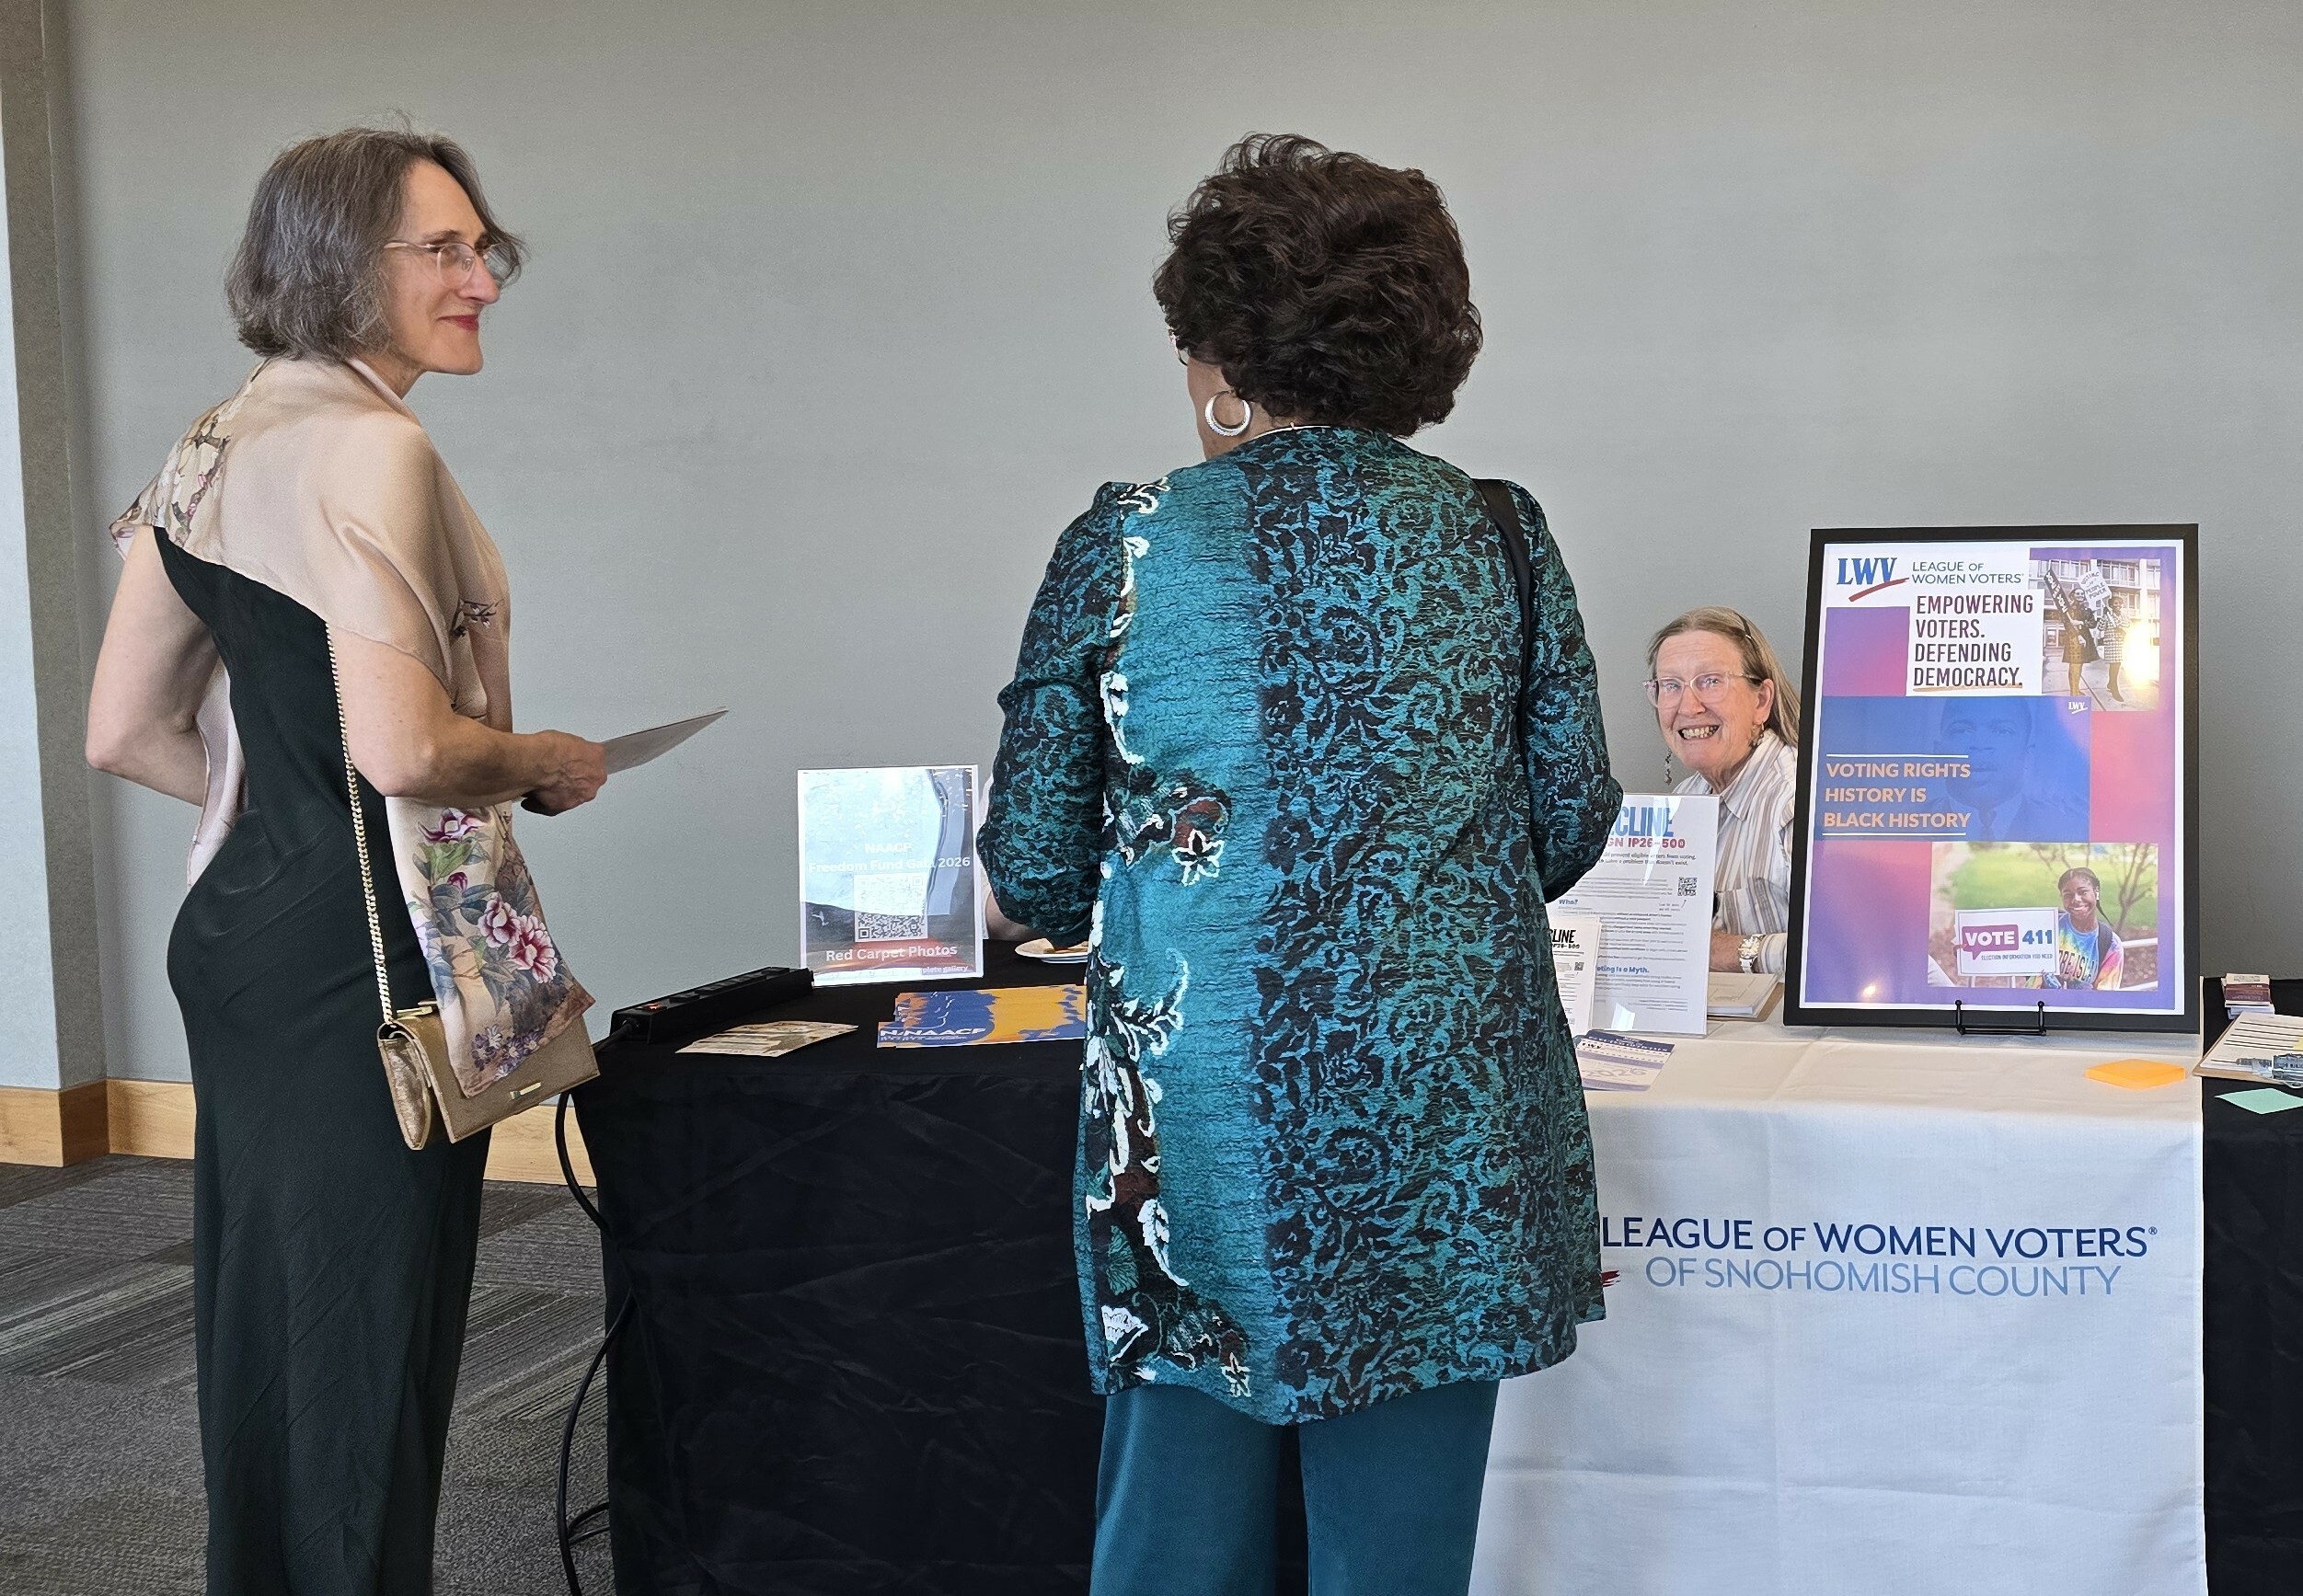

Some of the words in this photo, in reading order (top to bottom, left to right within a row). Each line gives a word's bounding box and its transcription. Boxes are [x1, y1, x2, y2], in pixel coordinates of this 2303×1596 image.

[1837, 557, 1897, 585] LWV
[1912, 561, 1964, 572] LEAGUE
[1968, 562, 1984, 571] OF
[1912, 573, 1966, 584] WOMEN
[1917, 594, 2033, 614] EMPOWERING
[1916, 619, 1986, 638] VOTERS.
[1915, 643, 2011, 662] DEFENDING
[1914, 667, 2023, 688] DEMOCRACY.
[2068, 702, 2087, 711] LWV
[1826, 763, 1899, 778] VOTING
[1903, 763, 1971, 778] RIGHTS
[1825, 787, 1906, 803] HISTORY
[1910, 787, 1927, 803] IS
[1611, 806, 1675, 837] CLINE
[1824, 812, 1885, 828] BLACK
[1889, 812, 1971, 828] HISTORY
[864, 842, 913, 854] NAACP
[808, 860, 868, 872] Freedom
[869, 859, 901, 870] Fund
[938, 856, 971, 867] 2026
[1964, 930, 2015, 946] VOTE
[2021, 929, 2053, 945] 411
[825, 949, 853, 961] Red
[857, 948, 905, 962] Carpet
[908, 945, 958, 958] Photos
[1629, 966, 1650, 974] Myth.
[1602, 1216, 1753, 1251] LEAGUE
[1763, 1226, 1806, 1251] OF
[1814, 1222, 1975, 1257] WOMEN
[1645, 1256, 1698, 1287] OF
[1704, 1257, 1940, 1294] SNOHOMISH
[1948, 1264, 2122, 1297] COUNTY
